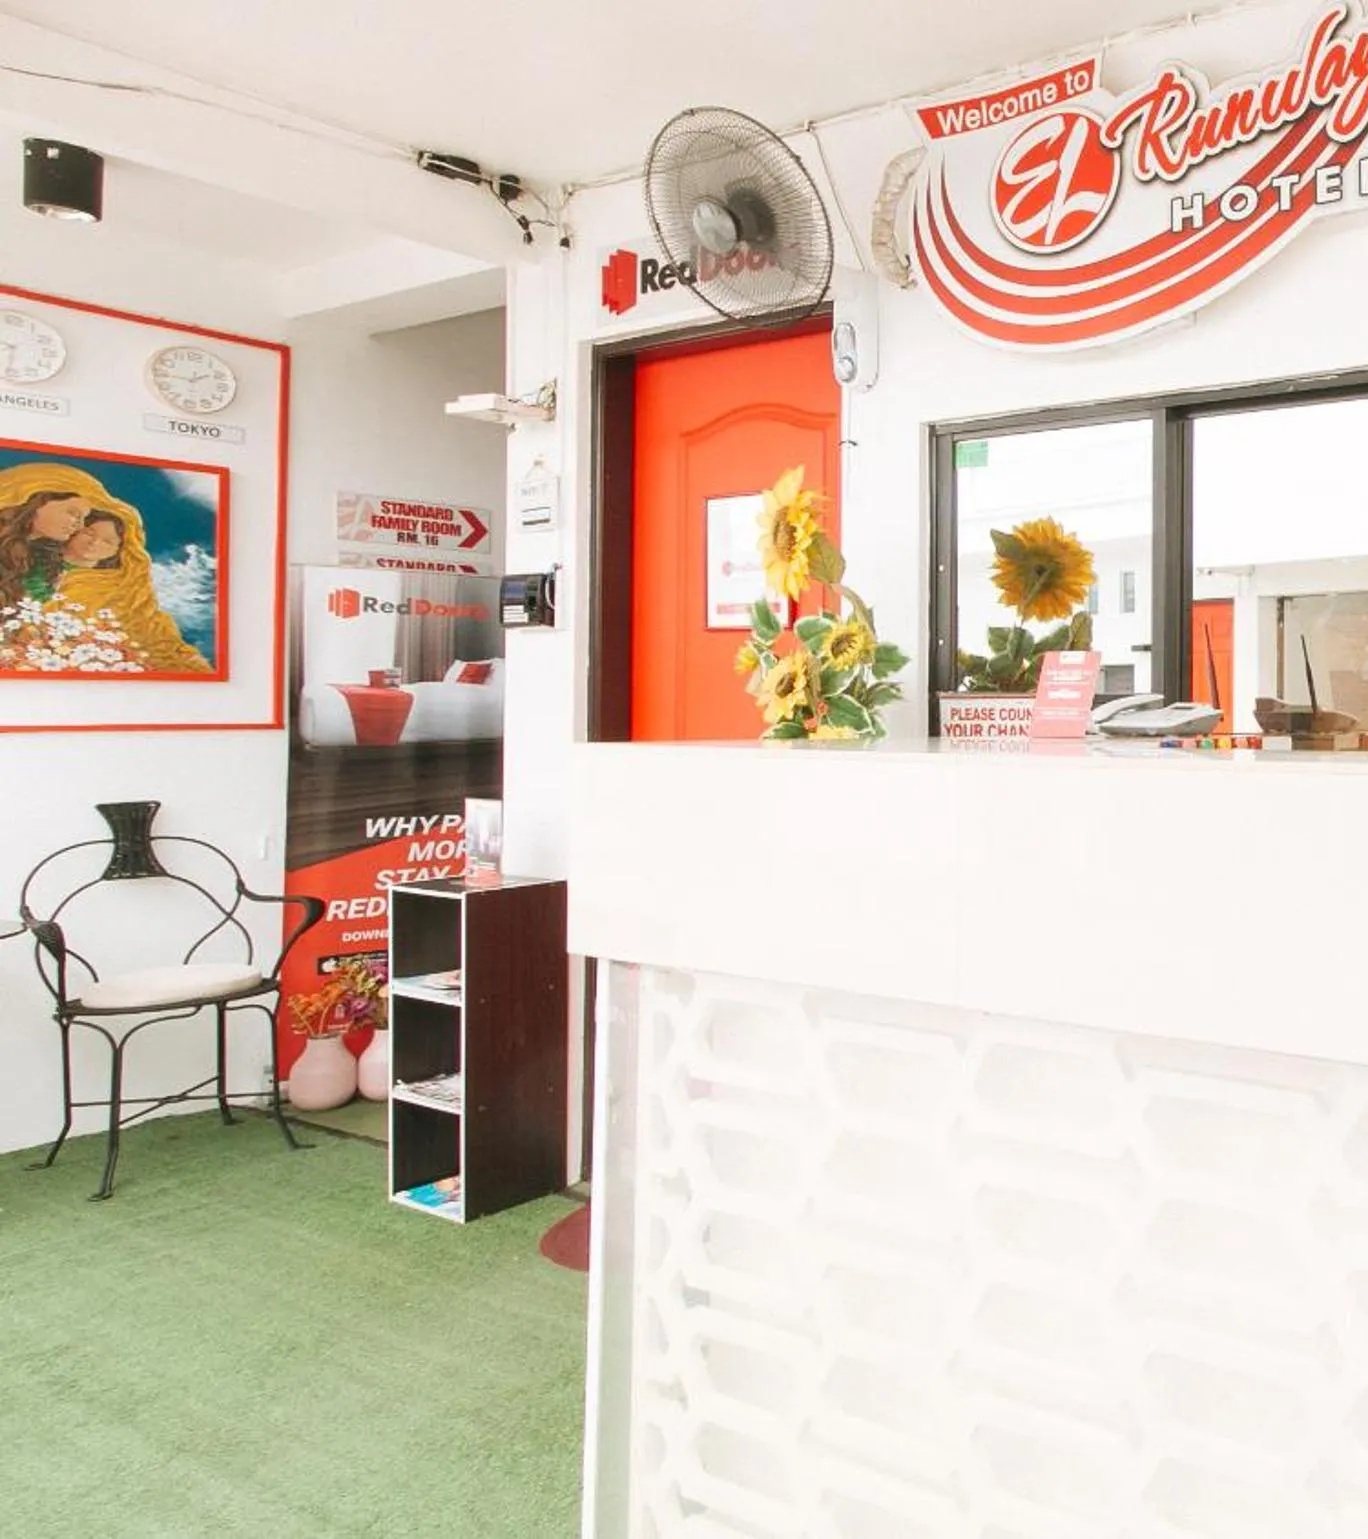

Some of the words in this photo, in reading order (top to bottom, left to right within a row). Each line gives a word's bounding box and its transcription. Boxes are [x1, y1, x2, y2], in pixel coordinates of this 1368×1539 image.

[936, 82, 1058, 136] Welcome
[1064, 70, 1090, 96] to
[168, 420, 221, 438] TOKYO
[380, 500, 454, 522] STANDARD
[371, 514, 419, 533] FAMILY
[421, 520, 462, 537] ROOM
[950, 706, 996, 721] PLEASE
[943, 723, 984, 738] YOUR
[365, 814, 440, 839] WHY
[325, 896, 388, 922] RED
